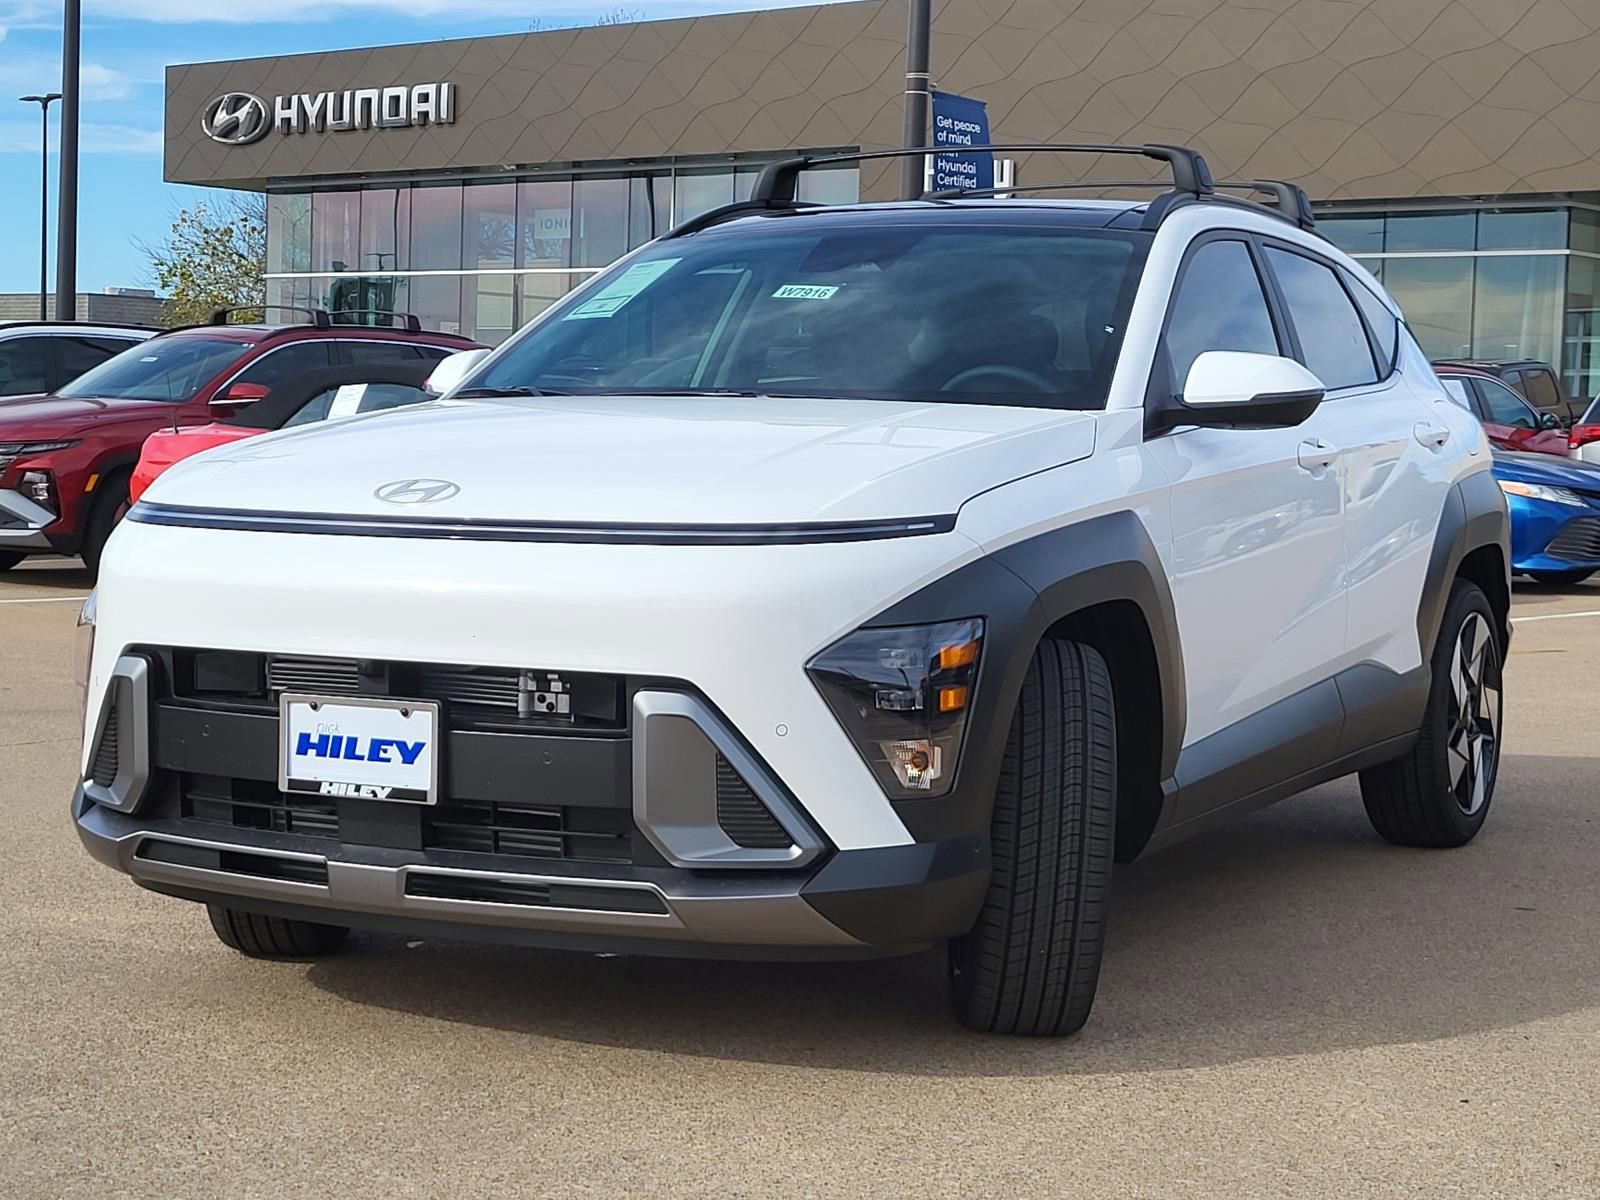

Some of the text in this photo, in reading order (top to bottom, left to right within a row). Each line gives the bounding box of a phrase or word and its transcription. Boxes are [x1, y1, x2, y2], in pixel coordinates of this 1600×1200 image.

[274, 82, 454, 135] HYUNDAI
[936, 115, 981, 133] Get peace
[937, 130, 971, 145] of mind
[937, 159, 977, 174] Hyundai
[937, 173, 977, 188] Certified
[540, 218, 570, 230] IONI
[780, 286, 830, 298] W7916
[295, 732, 426, 765] HILEY
[319, 781, 393, 799] HILEY
